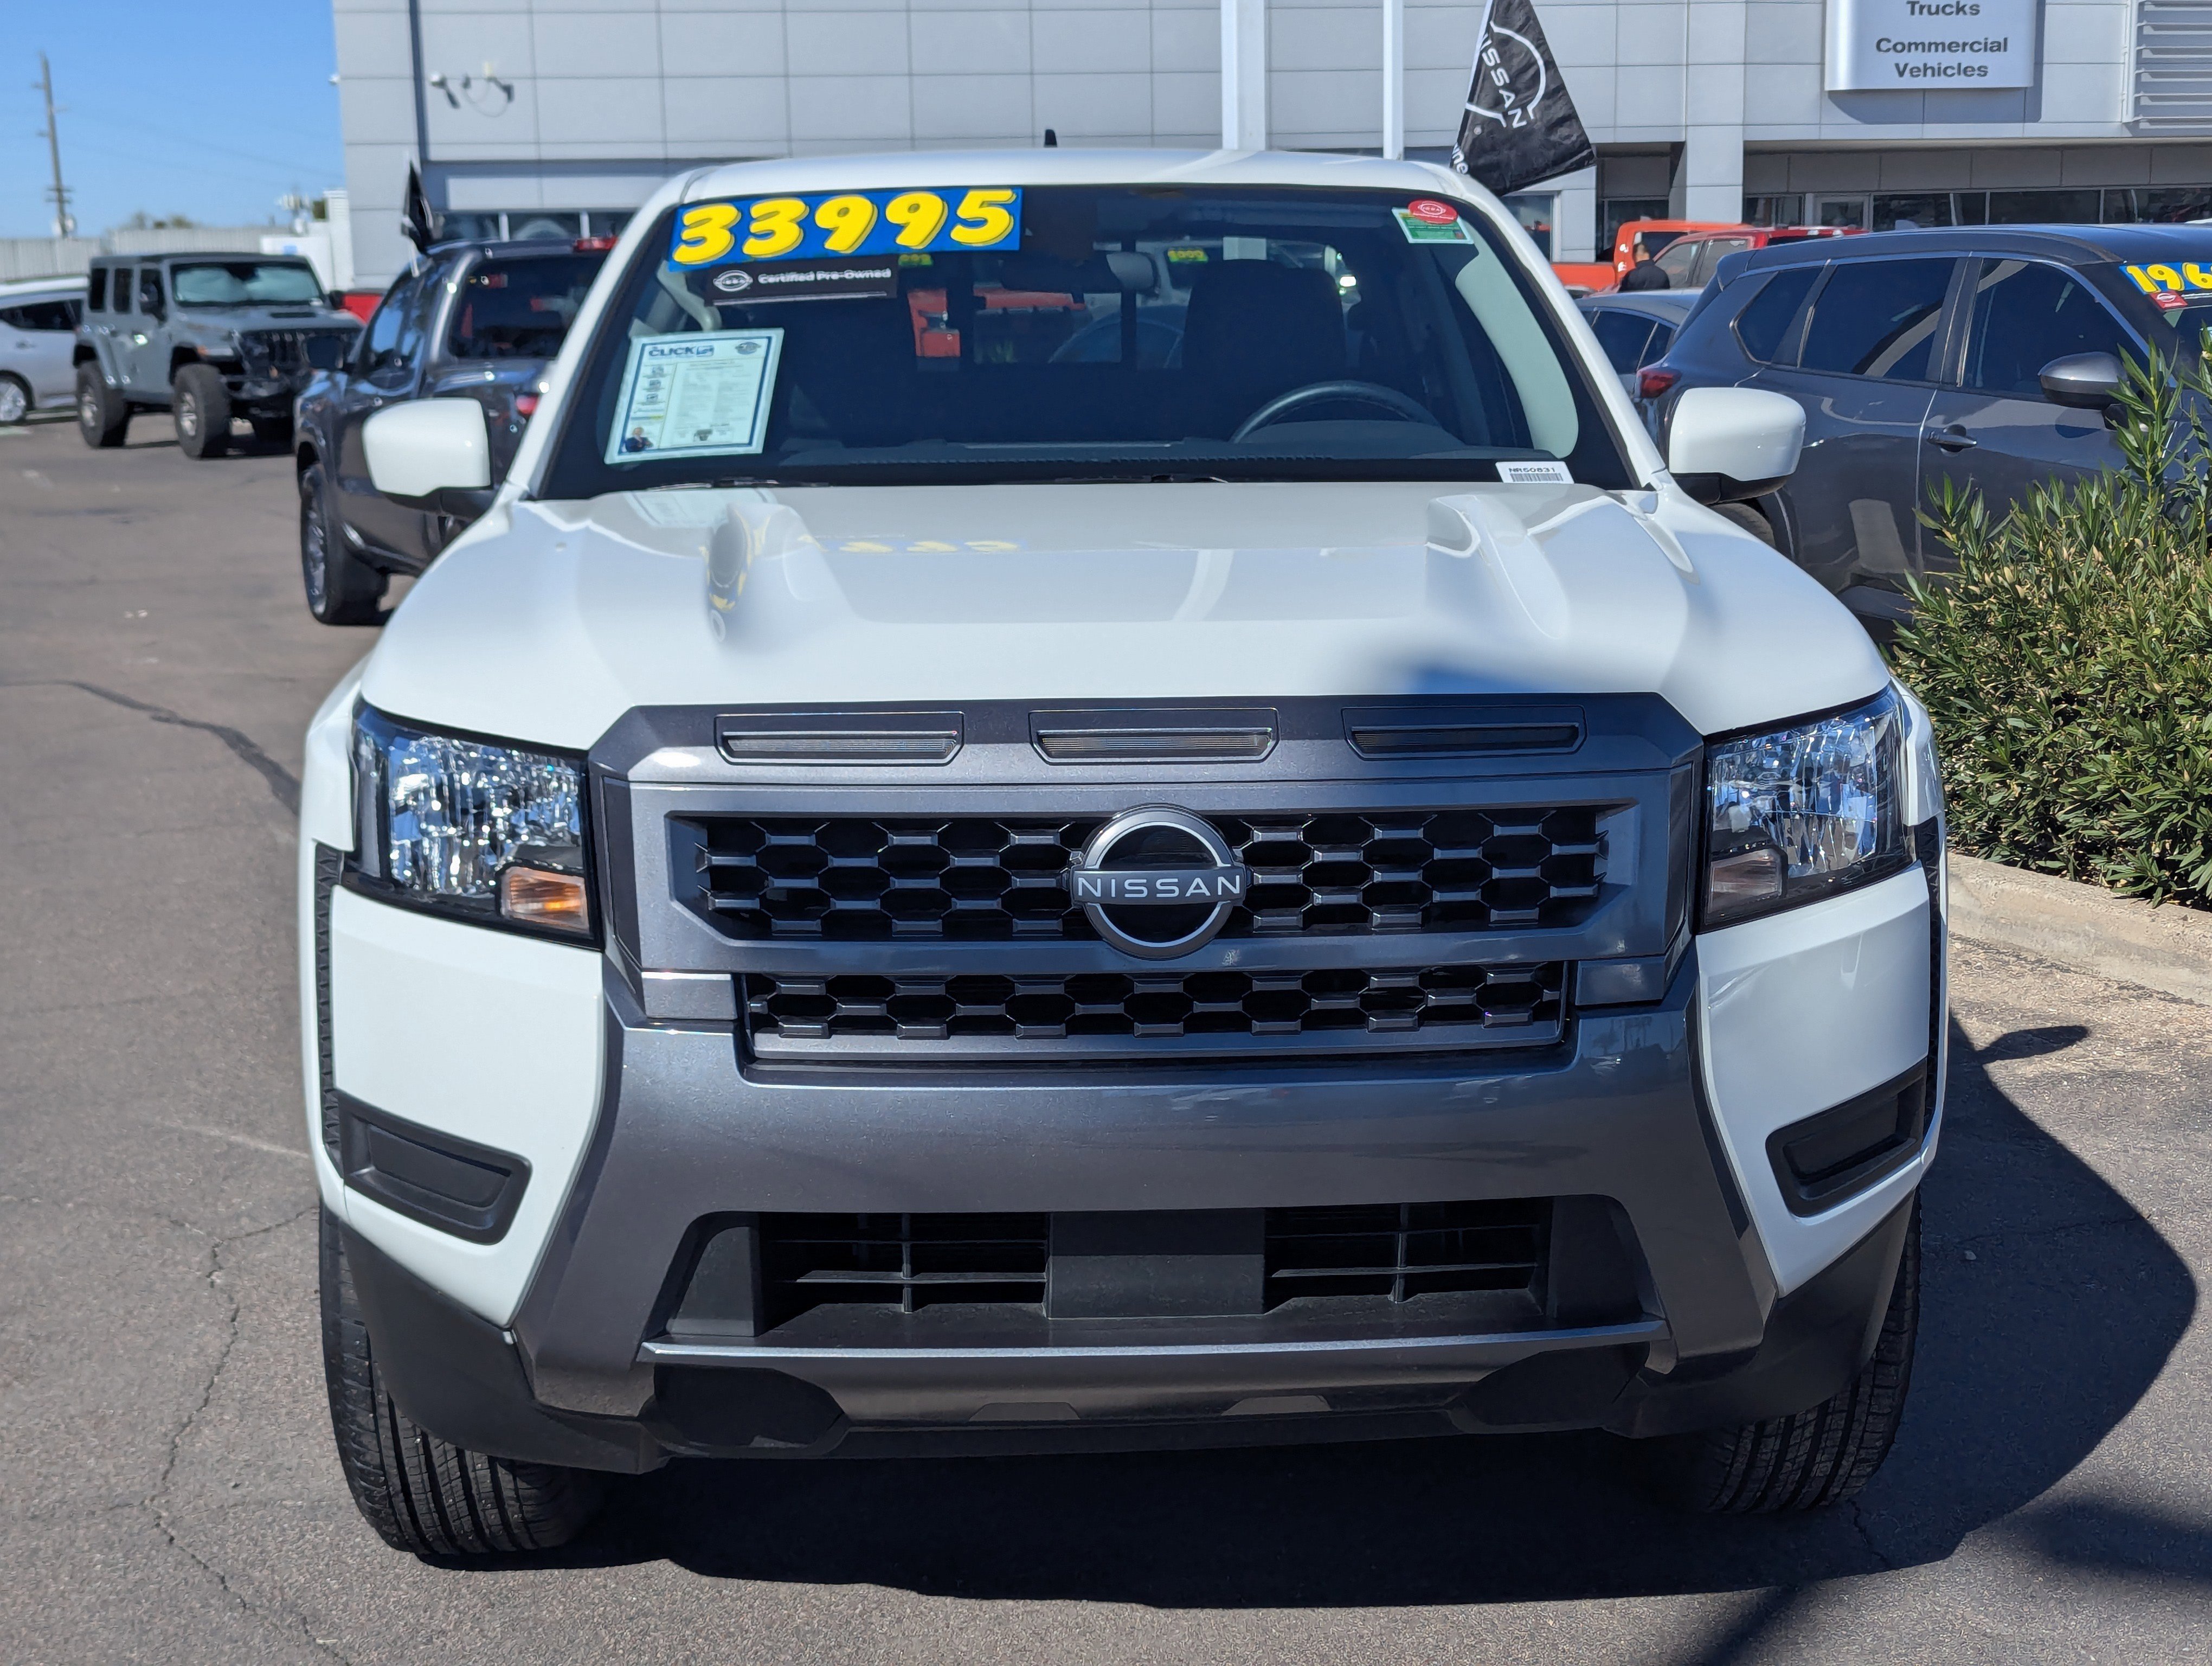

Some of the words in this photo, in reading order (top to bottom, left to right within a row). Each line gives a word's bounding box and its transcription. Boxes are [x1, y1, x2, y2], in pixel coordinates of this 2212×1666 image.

[1906, 1, 1980, 16] Trucks
[1876, 37, 2008, 53] Commercial
[1894, 62, 1989, 78] Vehicles
[1480, 33, 1527, 129] ISSAN
[673, 189, 1017, 264] 33995
[758, 271, 815, 284] Certified
[816, 268, 891, 280] Pre-Owned
[2126, 262, 2212, 292] 196
[1078, 875, 1240, 898] NISSAN
